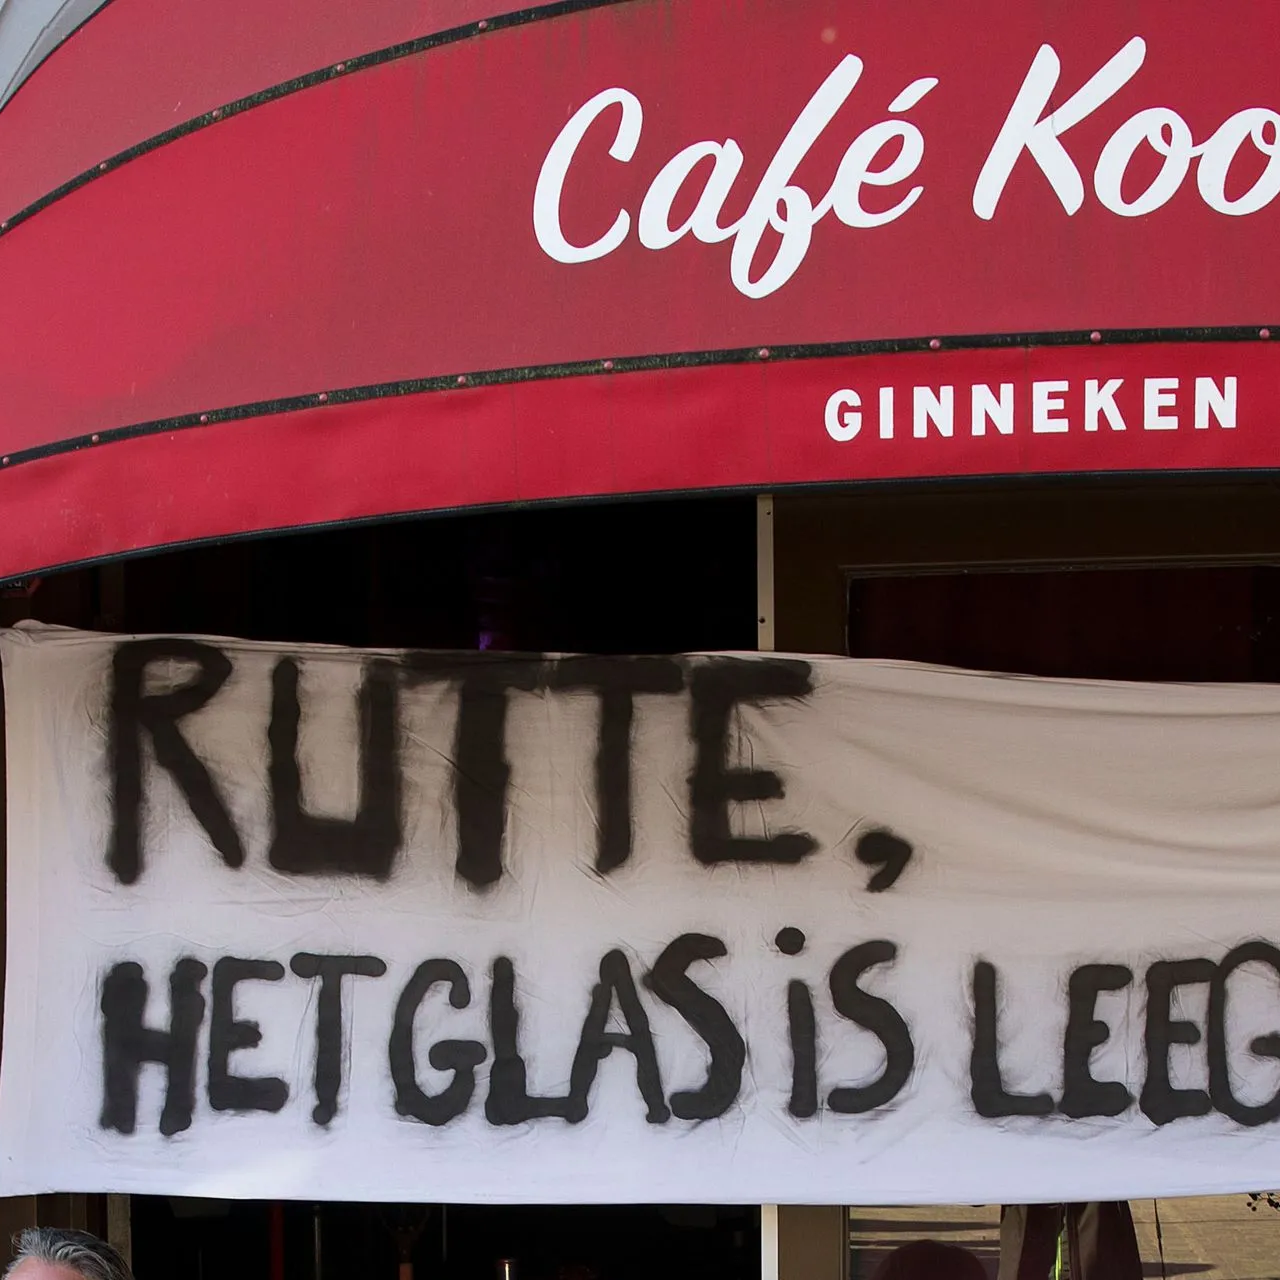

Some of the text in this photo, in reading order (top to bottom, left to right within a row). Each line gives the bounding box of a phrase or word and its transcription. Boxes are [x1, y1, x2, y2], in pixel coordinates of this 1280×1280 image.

[531, 52, 940, 300] Café
[825, 376, 1239, 443] GINNEKEN
[105, 638, 914, 895] RUTTE,
